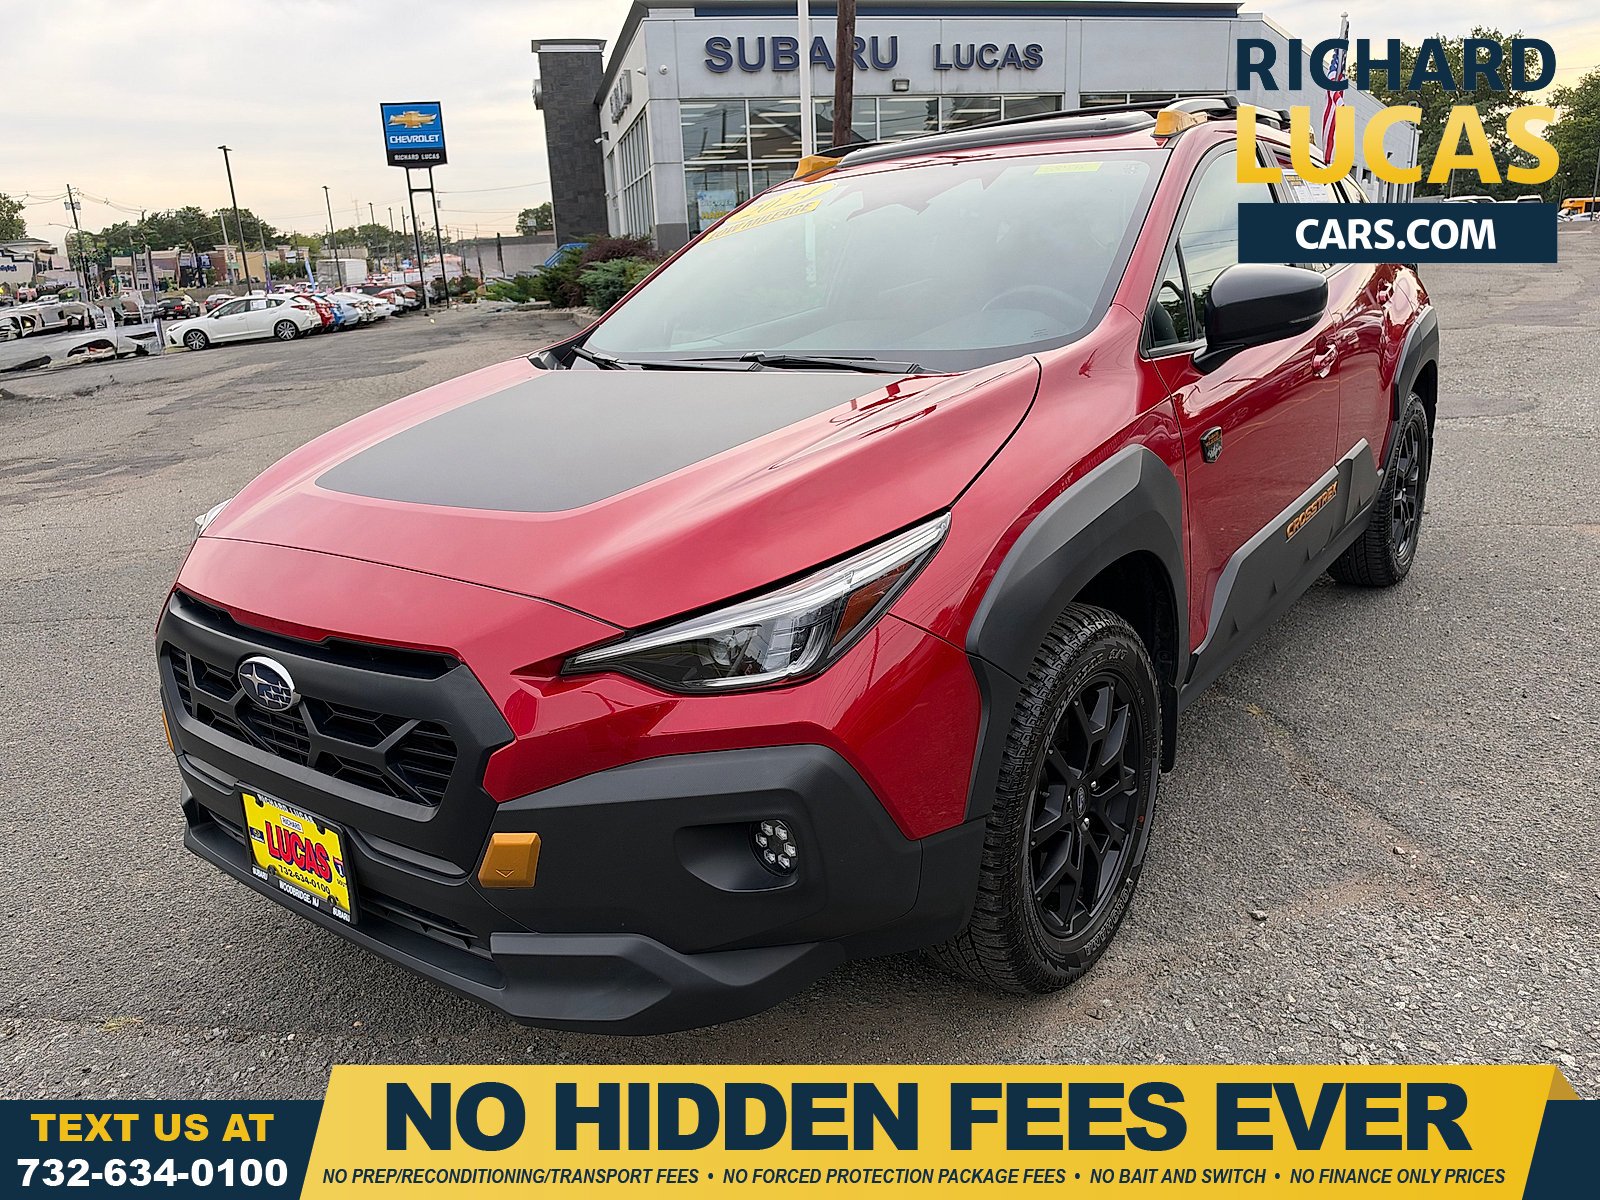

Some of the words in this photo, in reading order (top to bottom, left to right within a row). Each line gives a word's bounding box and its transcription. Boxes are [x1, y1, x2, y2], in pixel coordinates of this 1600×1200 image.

[704, 36, 898, 73] SUBARU
[933, 43, 1044, 71] LUCAS
[390, 134, 440, 144] CHEVROLET
[1285, 480, 1338, 540] CROSSTREK
[265, 820, 332, 883] LUCAS
